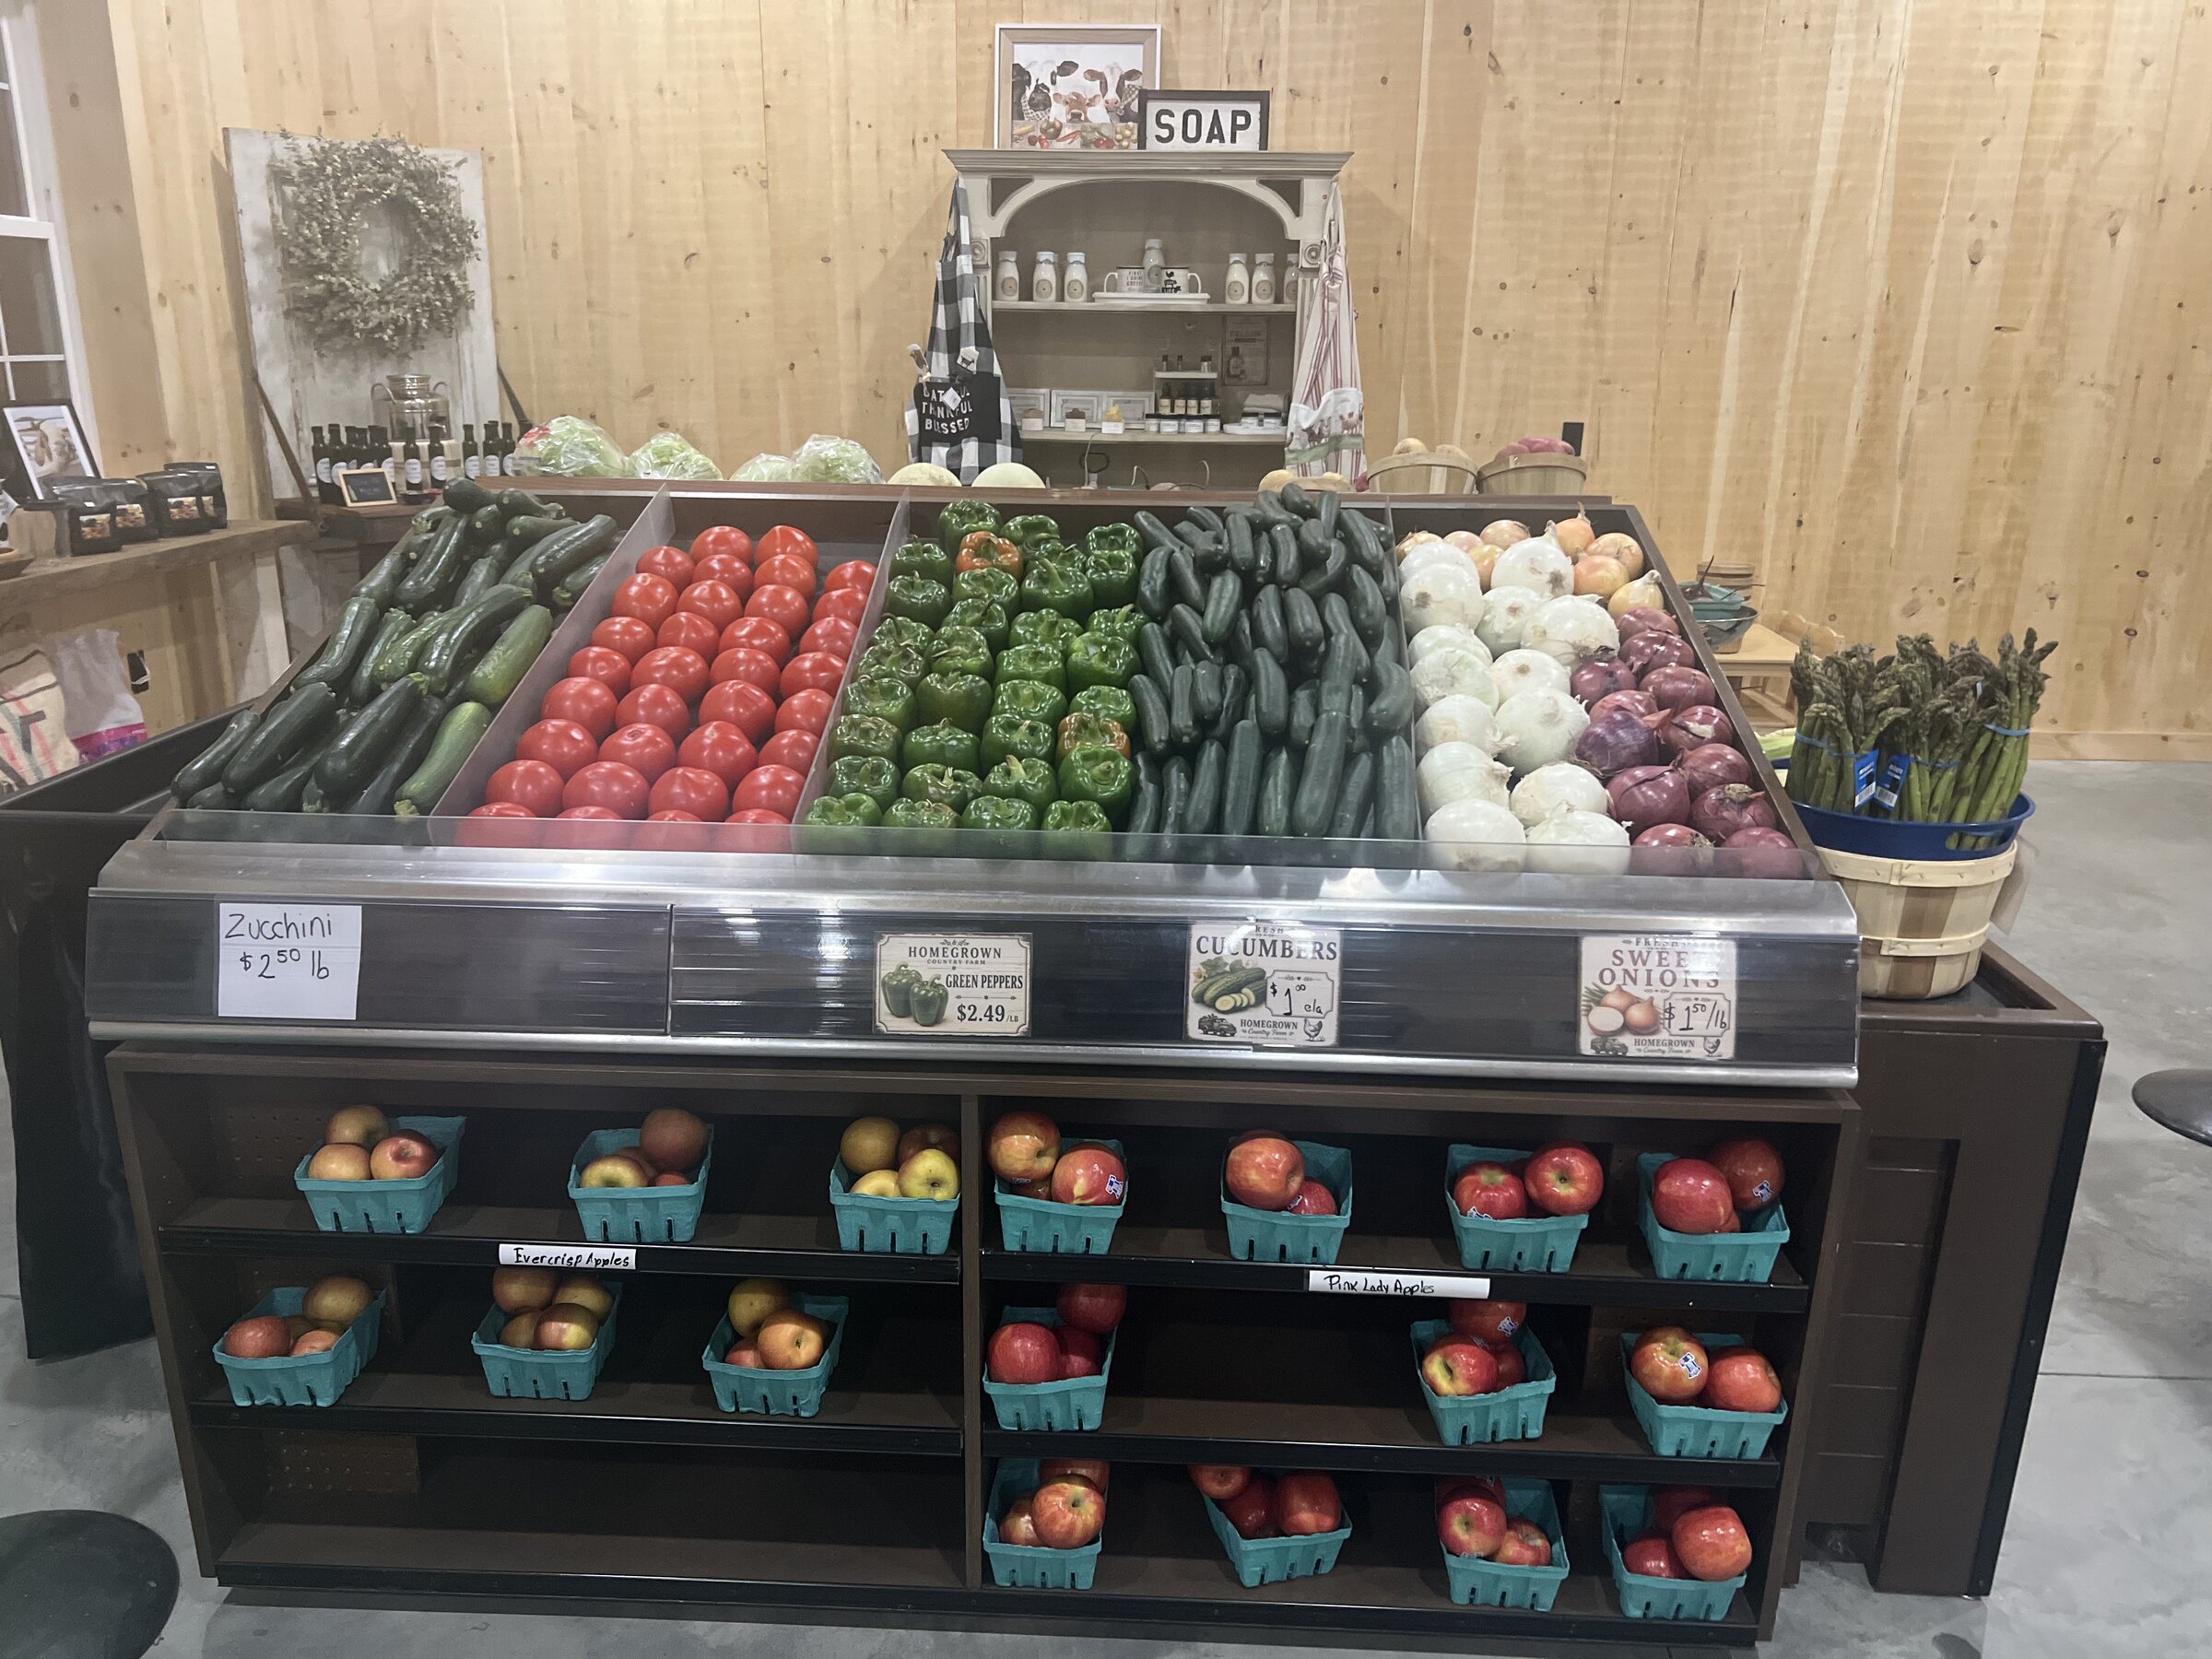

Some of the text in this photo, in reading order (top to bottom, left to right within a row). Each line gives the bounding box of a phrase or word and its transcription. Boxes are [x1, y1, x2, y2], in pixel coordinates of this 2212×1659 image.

[1155, 109, 1252, 144] SOAP
[225, 912, 332, 940] Zucchini
[1253, 924, 1285, 935] RESH
[909, 947, 1003, 959] HOMEGROWN
[1612, 949, 1691, 968] SWEE
[312, 950, 329, 980] lb
[946, 973, 1024, 990] GREEN PEPPERS
[1598, 967, 1720, 988] ONIONS
[1240, 1018, 1299, 1030] HOMEGROWN
[1634, 1038, 1696, 1048] HOMEGROWN
[513, 1247, 629, 1268] Evercrisp Apples
[1324, 1275, 1435, 1296] Pink Lady Apples
